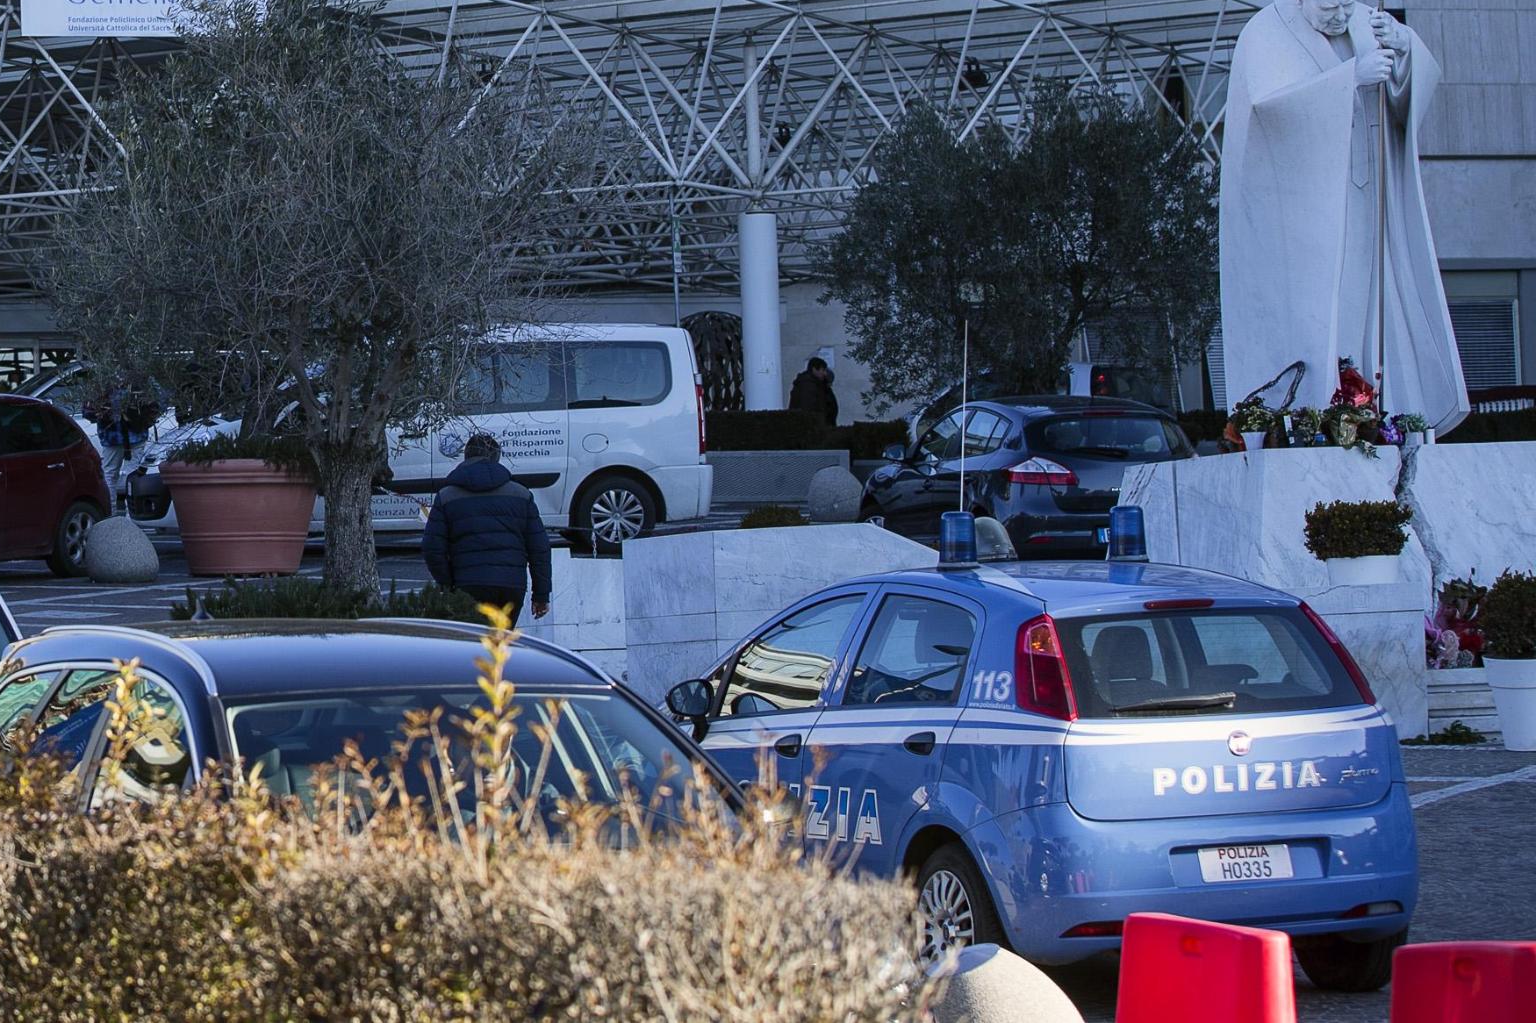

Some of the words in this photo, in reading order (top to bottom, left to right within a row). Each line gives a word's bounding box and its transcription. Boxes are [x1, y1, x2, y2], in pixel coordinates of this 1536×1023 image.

[67, 15, 109, 24] Fondazione
[110, 15, 146, 24] Policlinico
[106, 23, 138, 32] Cattolica
[139, 23, 151, 32] del
[502, 428, 561, 438] Fondazione
[512, 437, 565, 448] Risparmio
[973, 670, 1013, 702] 113
[1152, 760, 1321, 796] POLIZIA
[1217, 846, 1270, 860] POLIZIA
